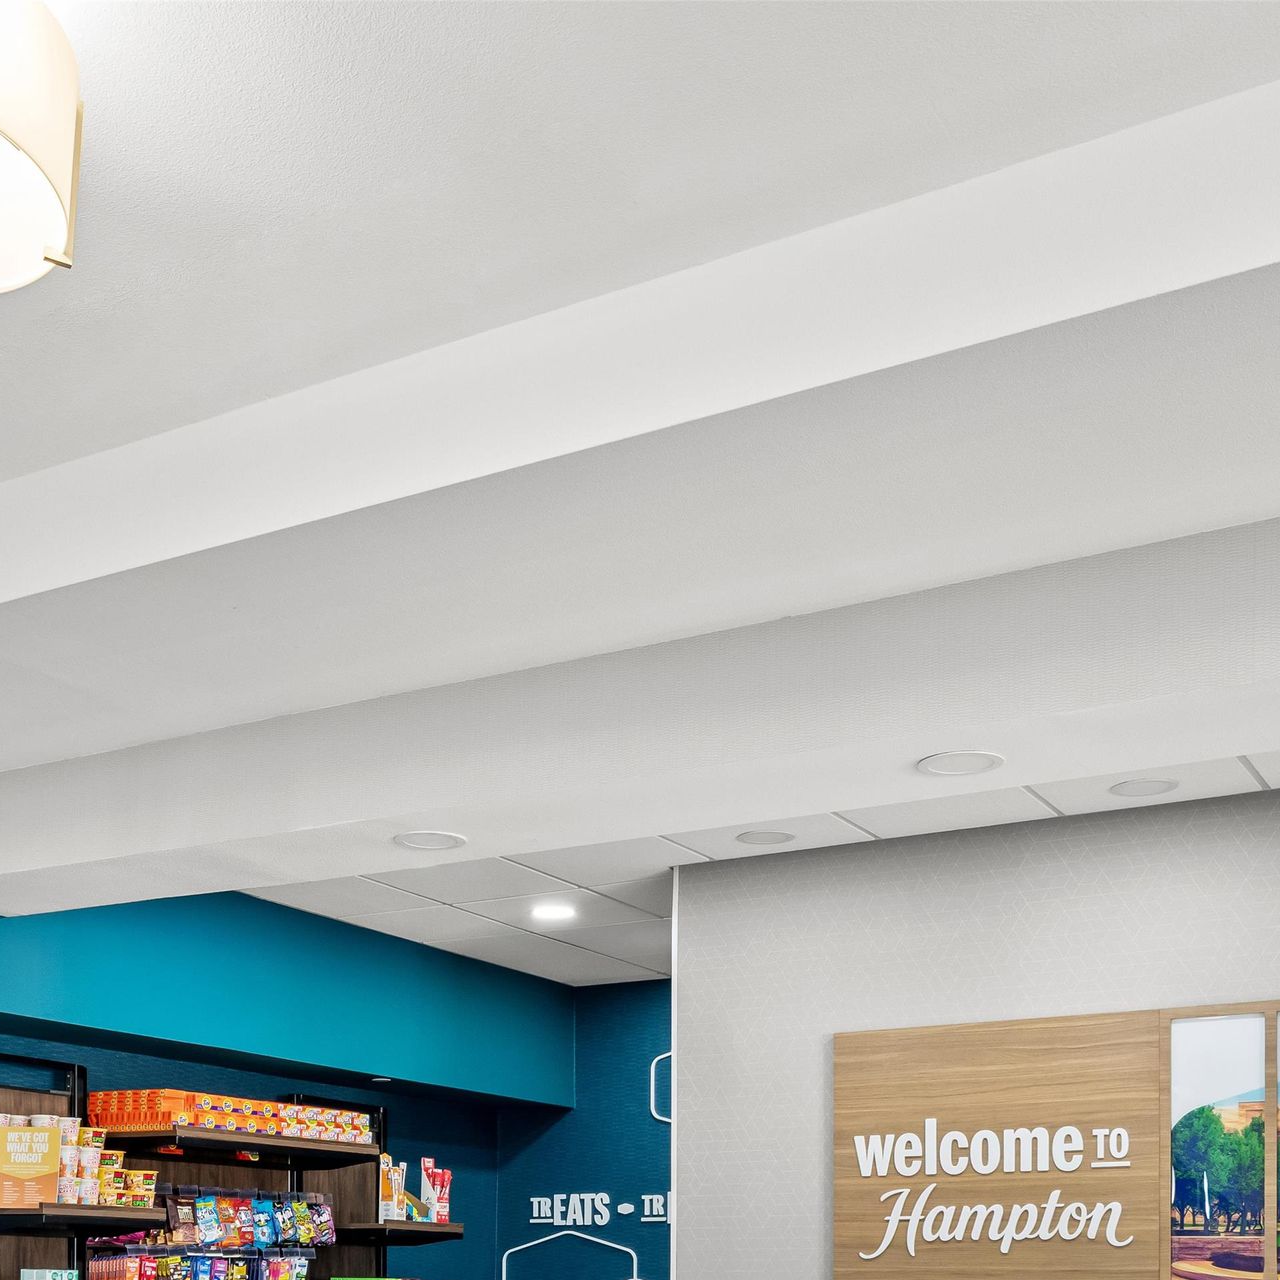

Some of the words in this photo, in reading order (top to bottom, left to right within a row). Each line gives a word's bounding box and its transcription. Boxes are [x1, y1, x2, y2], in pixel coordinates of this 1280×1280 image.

[6, 1143, 30, 1153] WHAT
[32, 1143, 48, 1153] YOU
[7, 1132, 31, 1142] WE'VE
[33, 1132, 49, 1142] GOT
[853, 1118, 1085, 1178] welcome
[1091, 1127, 1131, 1164] TO
[11, 1153, 42, 1163] FORGOT
[529, 1193, 610, 1226] TREATS
[640, 1191, 671, 1224] TR
[858, 1183, 1135, 1260] Hampton
